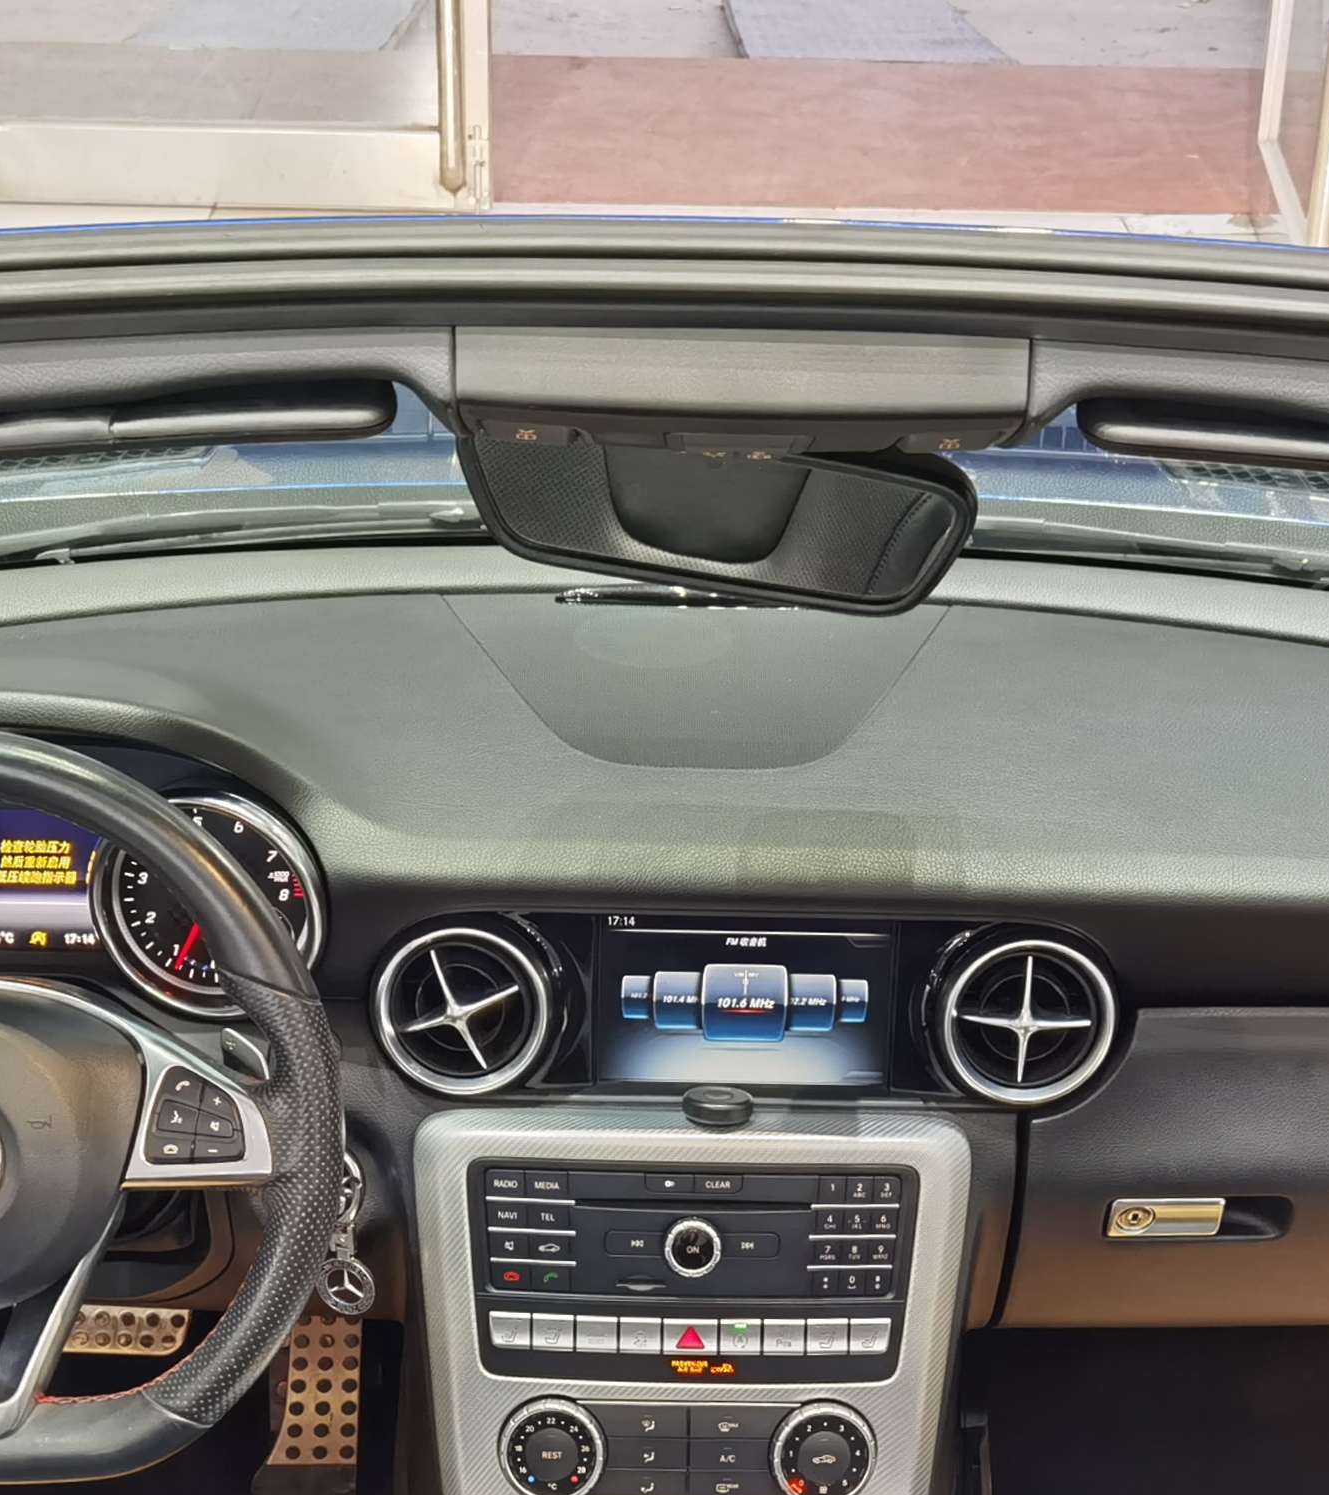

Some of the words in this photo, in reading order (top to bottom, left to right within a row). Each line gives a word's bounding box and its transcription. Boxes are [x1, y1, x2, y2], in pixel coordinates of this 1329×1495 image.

[233, 821, 244, 834] 6
[266, 850, 278, 863] 7
[137, 871, 149, 885] 3
[278, 888, 290, 902] 8
[145, 911, 157, 924] 2
[607, 915, 636, 927] 17:14
[63, 932, 96, 946] 17:14
[717, 997, 747, 1009] 101.6
[749, 997, 776, 1009] MHz
[493, 1179, 519, 1189] RADIO
[534, 1181, 560, 1191] MEDIA
[705, 1180, 731, 1189] CLEAR
[855, 1183, 863, 1192] 2
[883, 1182, 891, 1192] 3
[497, 1210, 518, 1220] NAVI
[540, 1213, 556, 1222] TEL
[686, 1245, 700, 1255] ON
[546, 1417, 556, 1425] 22
[525, 1425, 535, 1433] 20
[569, 1425, 579, 1433] 24
[514, 1444, 523, 1452] 18
[580, 1444, 591, 1453] 26
[541, 1450, 563, 1460] REST
[719, 1454, 736, 1463] A/C
[518, 1465, 528, 1474] 16
[576, 1465, 587, 1475] 28
